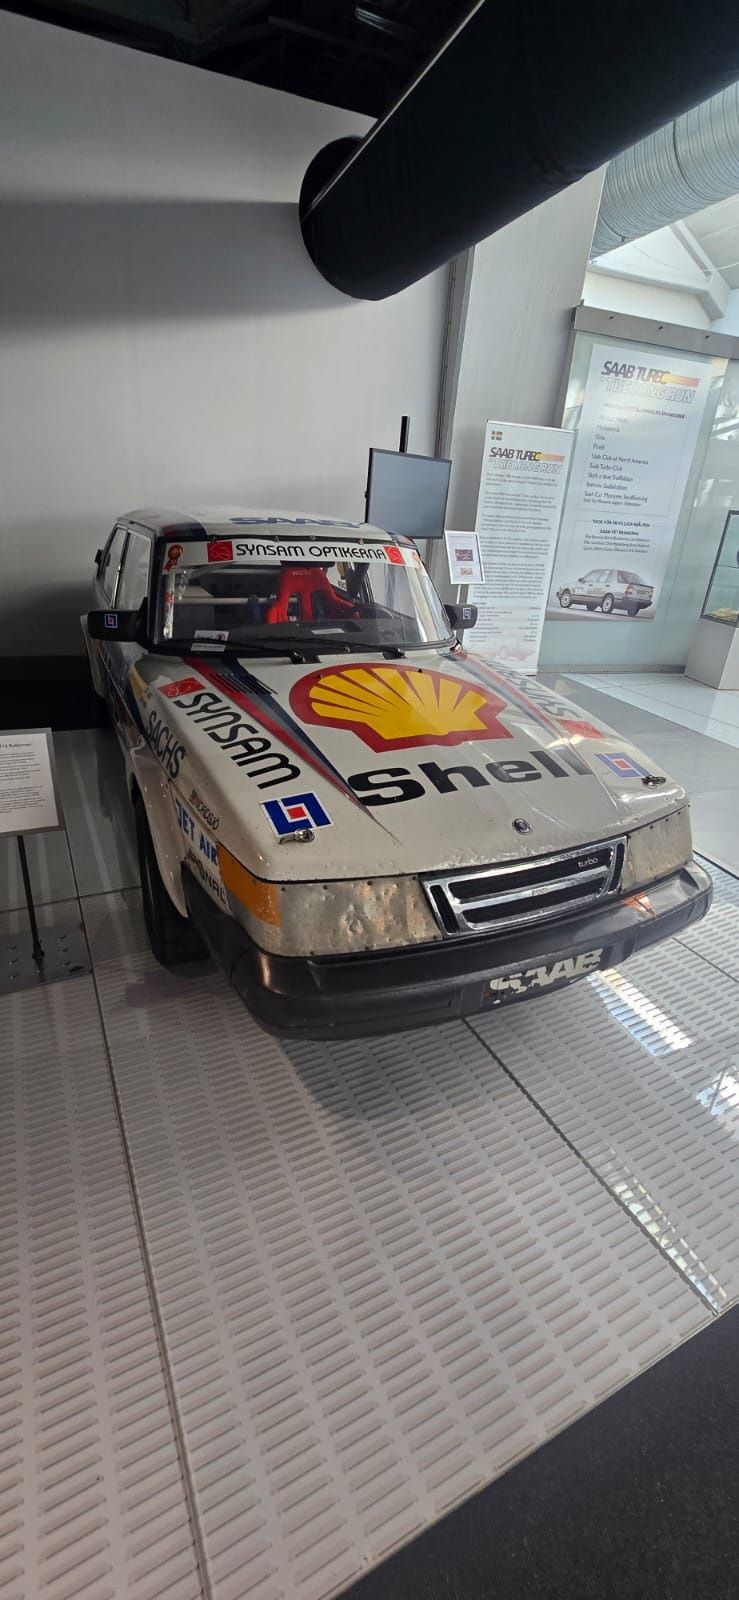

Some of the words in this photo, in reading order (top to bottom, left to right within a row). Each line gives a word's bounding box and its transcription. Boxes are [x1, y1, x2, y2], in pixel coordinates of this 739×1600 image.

[601, 361, 635, 378] SAAB
[489, 447, 515, 459] SAAB
[236, 544, 306, 557] SYNSAM
[309, 546, 387, 560] OPTIKERNA
[147, 710, 186, 779] SACHS
[174, 692, 301, 789] SYNSAM
[347, 750, 596, 807] Shell
[200, 832, 217, 866] AIR
[578, 857, 598, 868] turbo
[490, 948, 603, 994] SAAB
